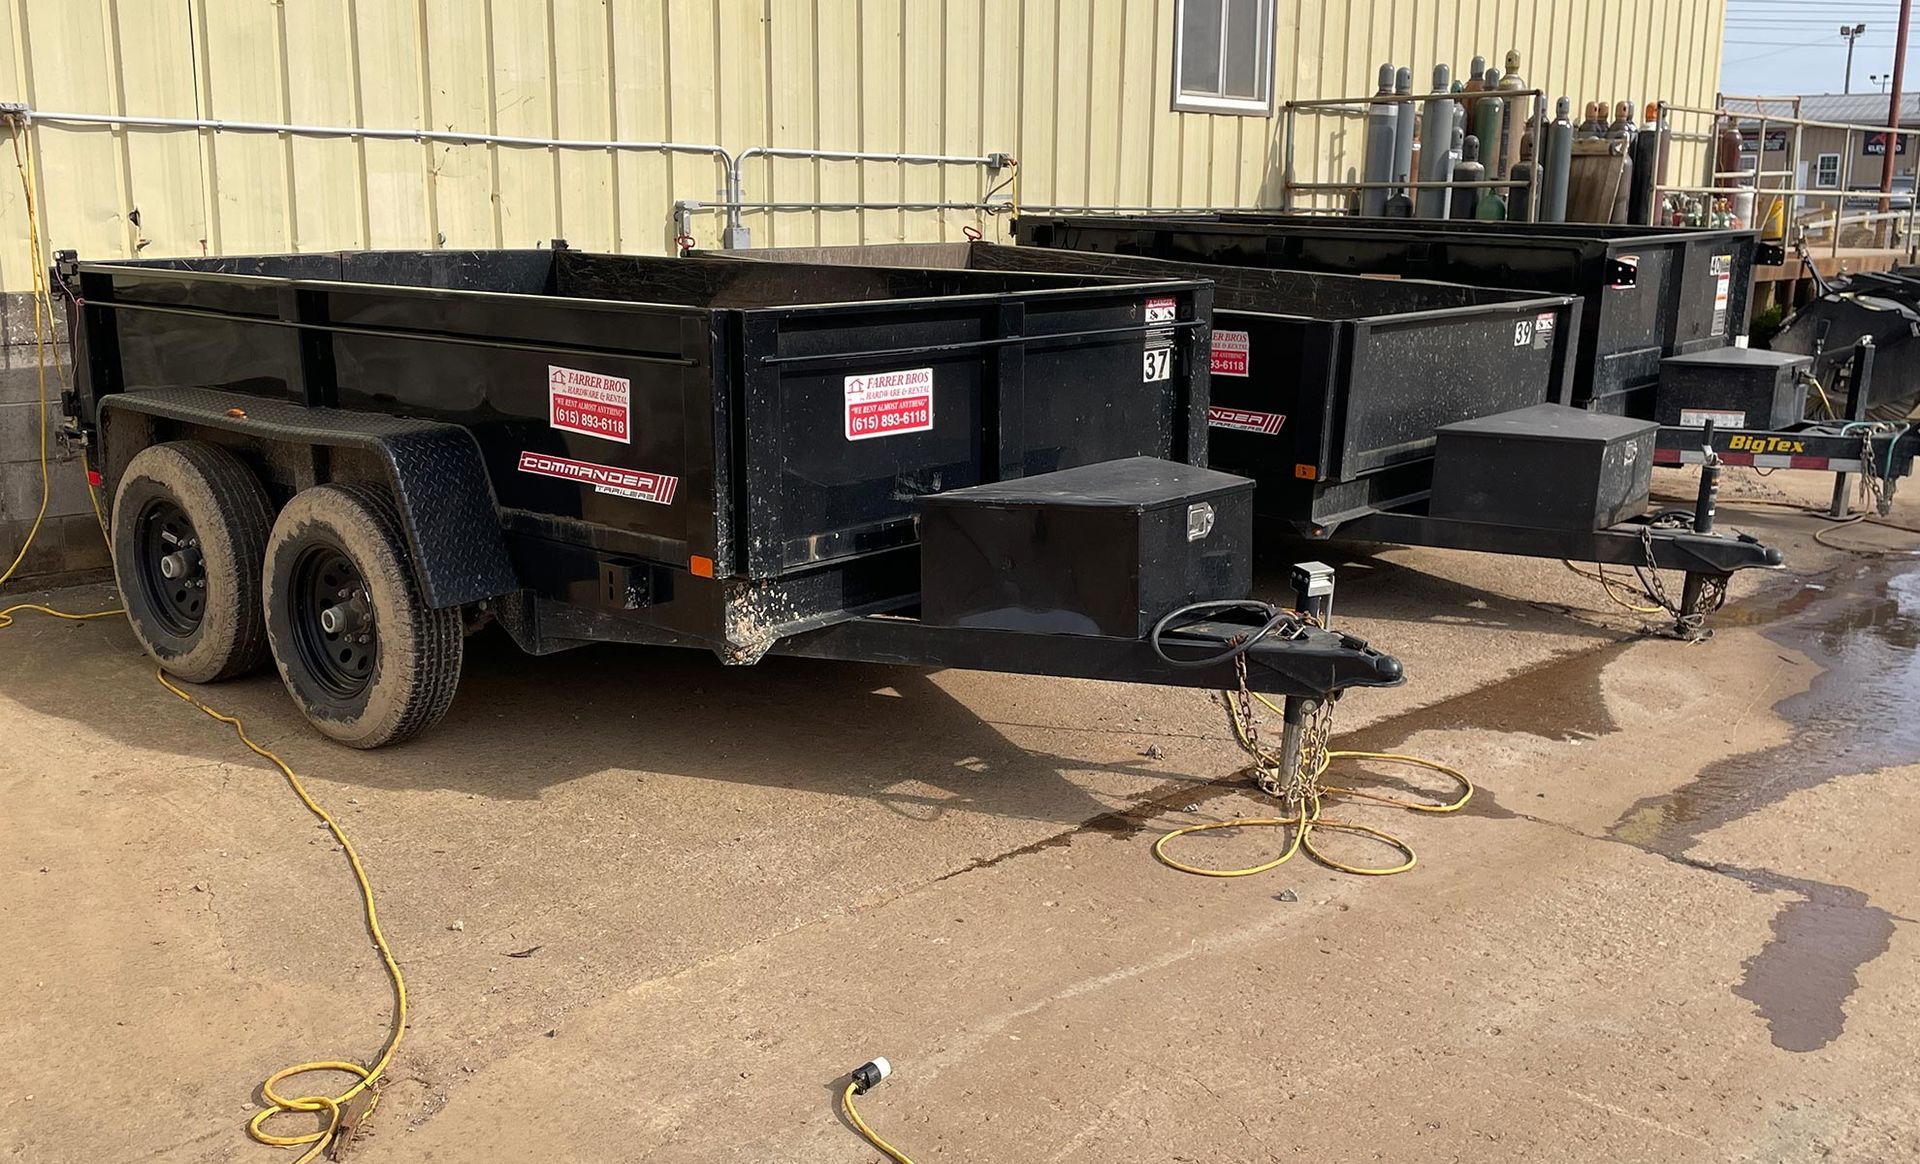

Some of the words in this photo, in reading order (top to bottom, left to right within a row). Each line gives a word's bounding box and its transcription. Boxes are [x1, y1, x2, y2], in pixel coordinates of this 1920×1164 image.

[1224, 333, 1248, 342] BROS
[1515, 321, 1531, 344] 39
[1145, 350, 1169, 380] 37
[1210, 359, 1244, 370] 93-6118
[568, 372, 602, 389] FARRER
[603, 379, 627, 394] BROS
[867, 374, 905, 389] FARRER
[905, 371, 930, 386] BROS
[567, 386, 599, 399] HARDWARE
[600, 392, 606, 401] &
[606, 393, 628, 404] RENTAL
[866, 388, 900, 400] HARDWARE
[901, 388, 907, 396] &
[908, 385, 930, 395] RENTAL
[565, 398, 578, 408] RENT
[578, 400, 597, 412] ALMOST
[863, 404, 878, 414] RENT
[878, 402, 899, 412] ALMOST
[556, 406, 579, 425] (615)
[581, 413, 625, 434] 893-6118
[852, 413, 879, 433] (615)
[881, 409, 927, 427] 893-6118
[1728, 434, 1806, 454] BigTex
[523, 457, 654, 489] COMMANDER
[596, 485, 655, 500] TRAILERS
